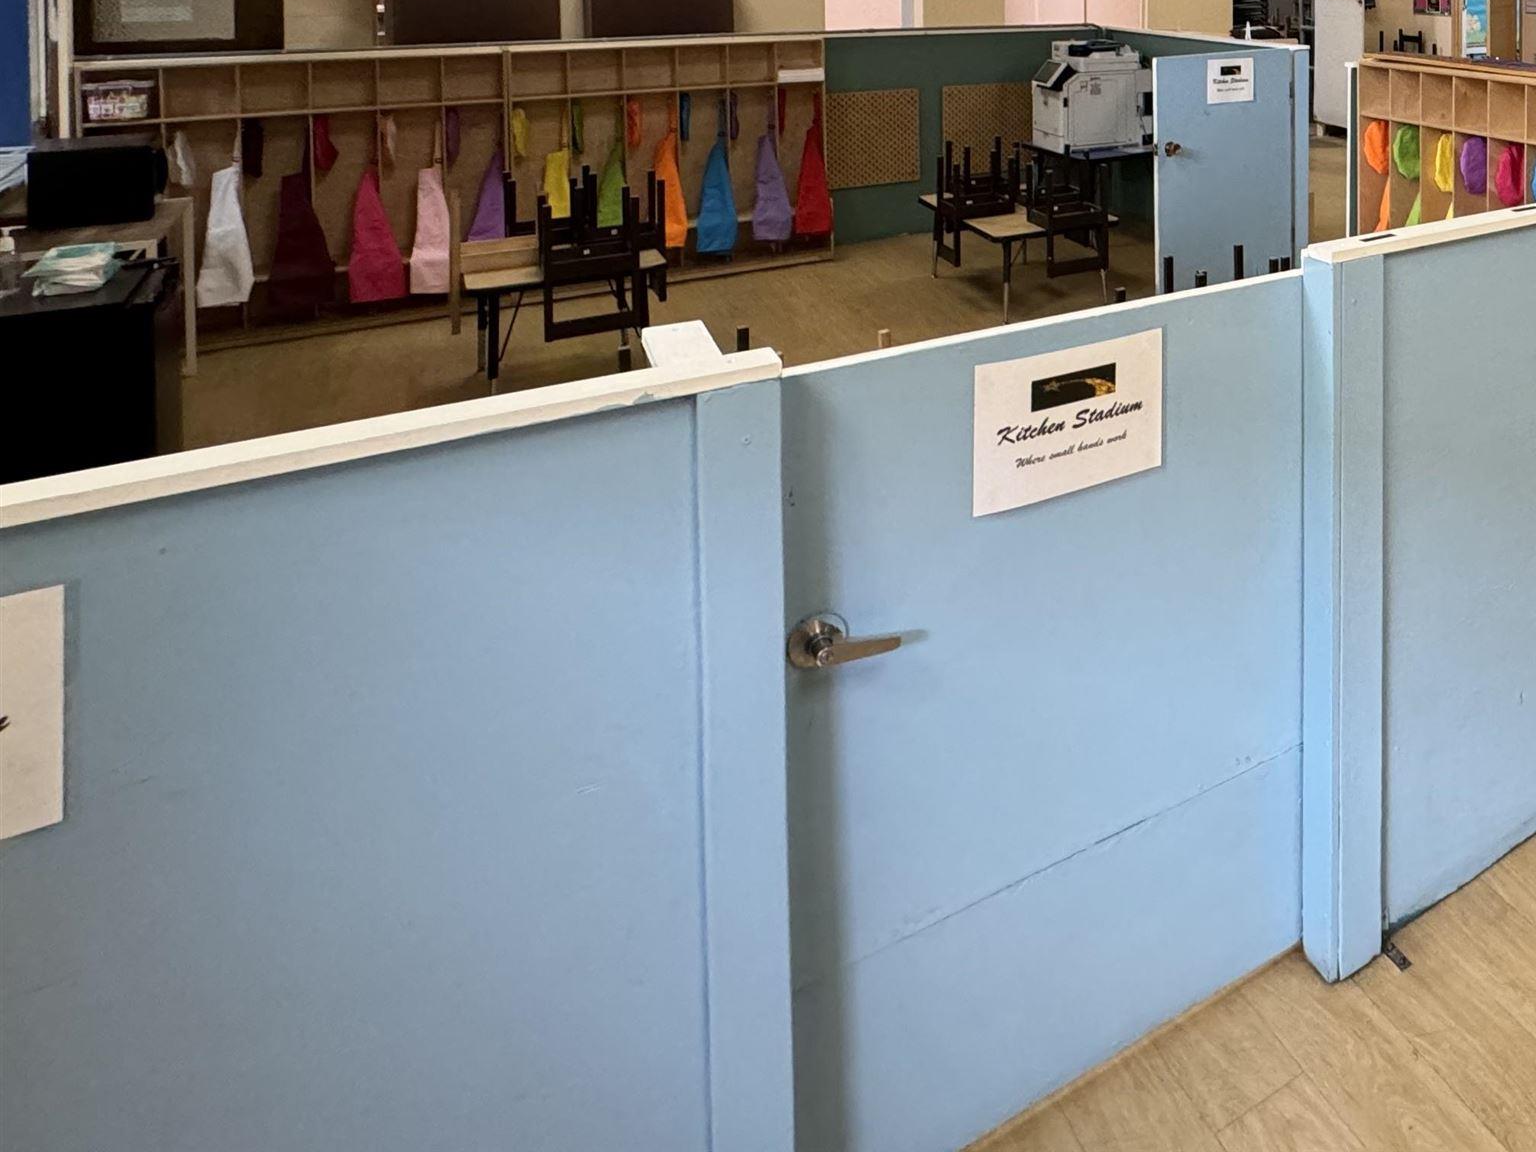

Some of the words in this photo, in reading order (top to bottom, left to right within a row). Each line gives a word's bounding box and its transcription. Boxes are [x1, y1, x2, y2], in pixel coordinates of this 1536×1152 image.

[996, 416, 1066, 447] Kitchen
[1072, 400, 1144, 429] Stadium
[1014, 454, 1046, 469] Where
[1049, 445, 1075, 461] small
[1077, 438, 1104, 453] hands
[1106, 429, 1128, 444] work
